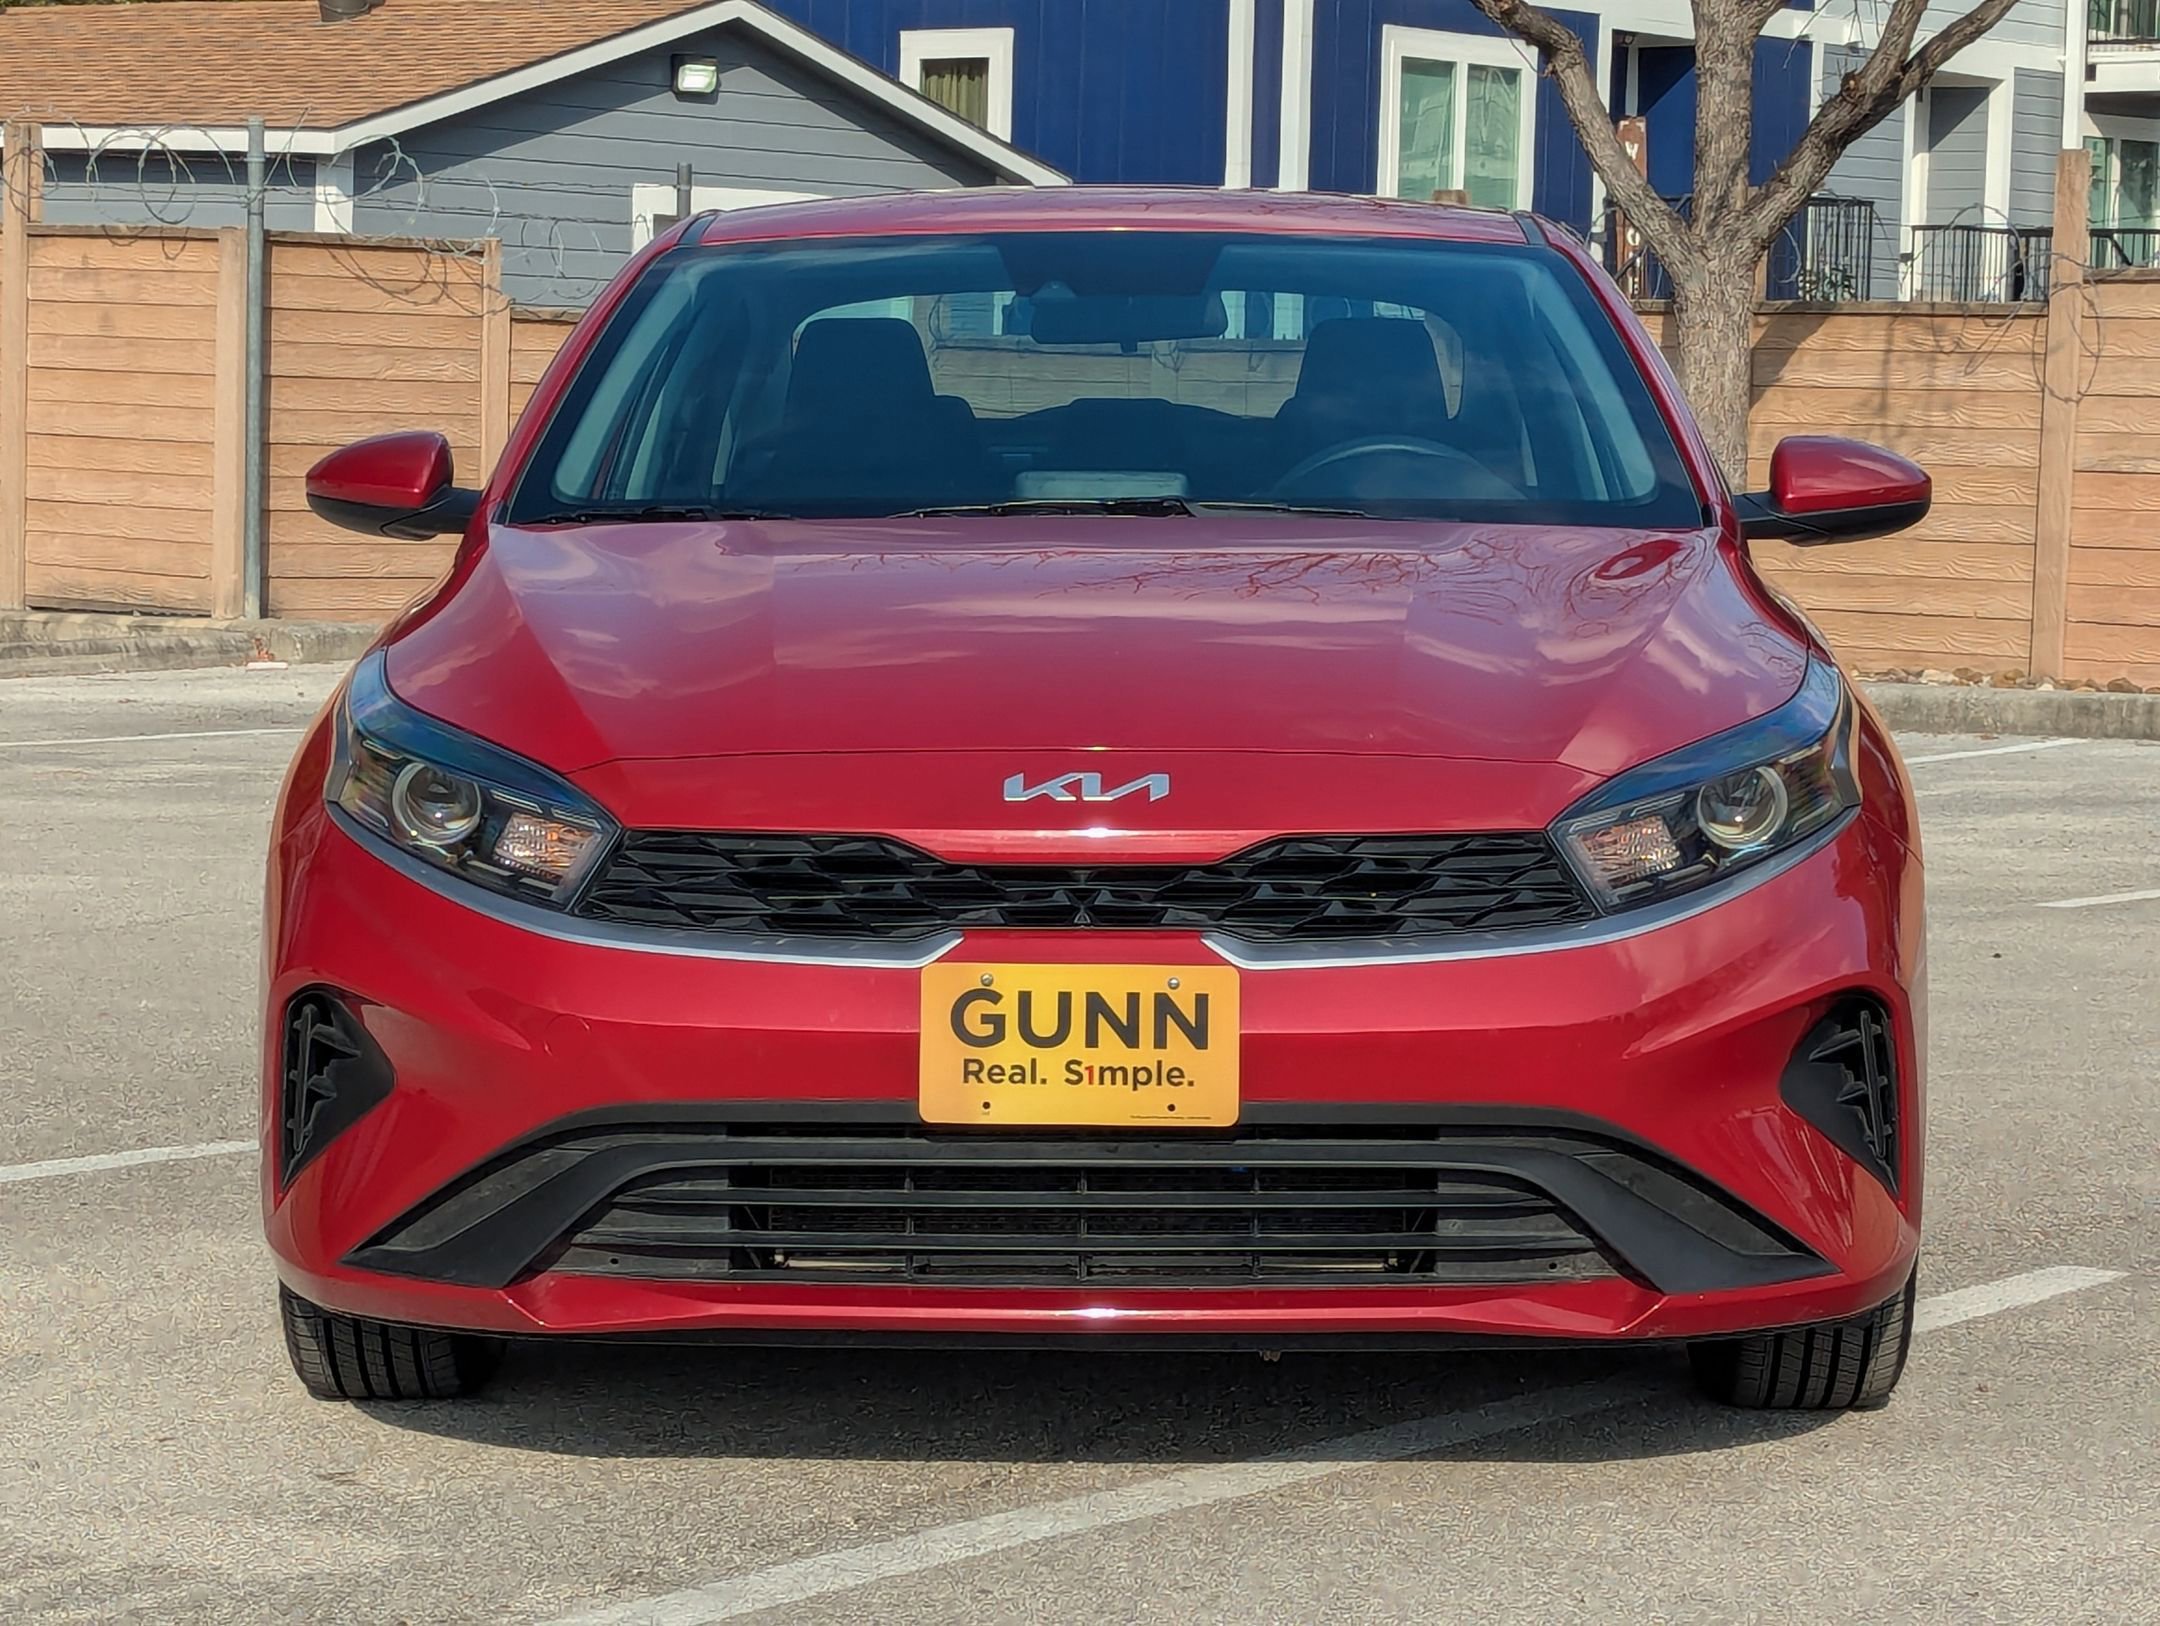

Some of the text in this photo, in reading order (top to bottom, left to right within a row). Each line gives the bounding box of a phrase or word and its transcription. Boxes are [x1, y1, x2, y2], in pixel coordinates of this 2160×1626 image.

[1004, 772, 1169, 801] KIA
[950, 988, 1209, 1050] GUNN
[962, 1058, 1048, 1085] Real.
